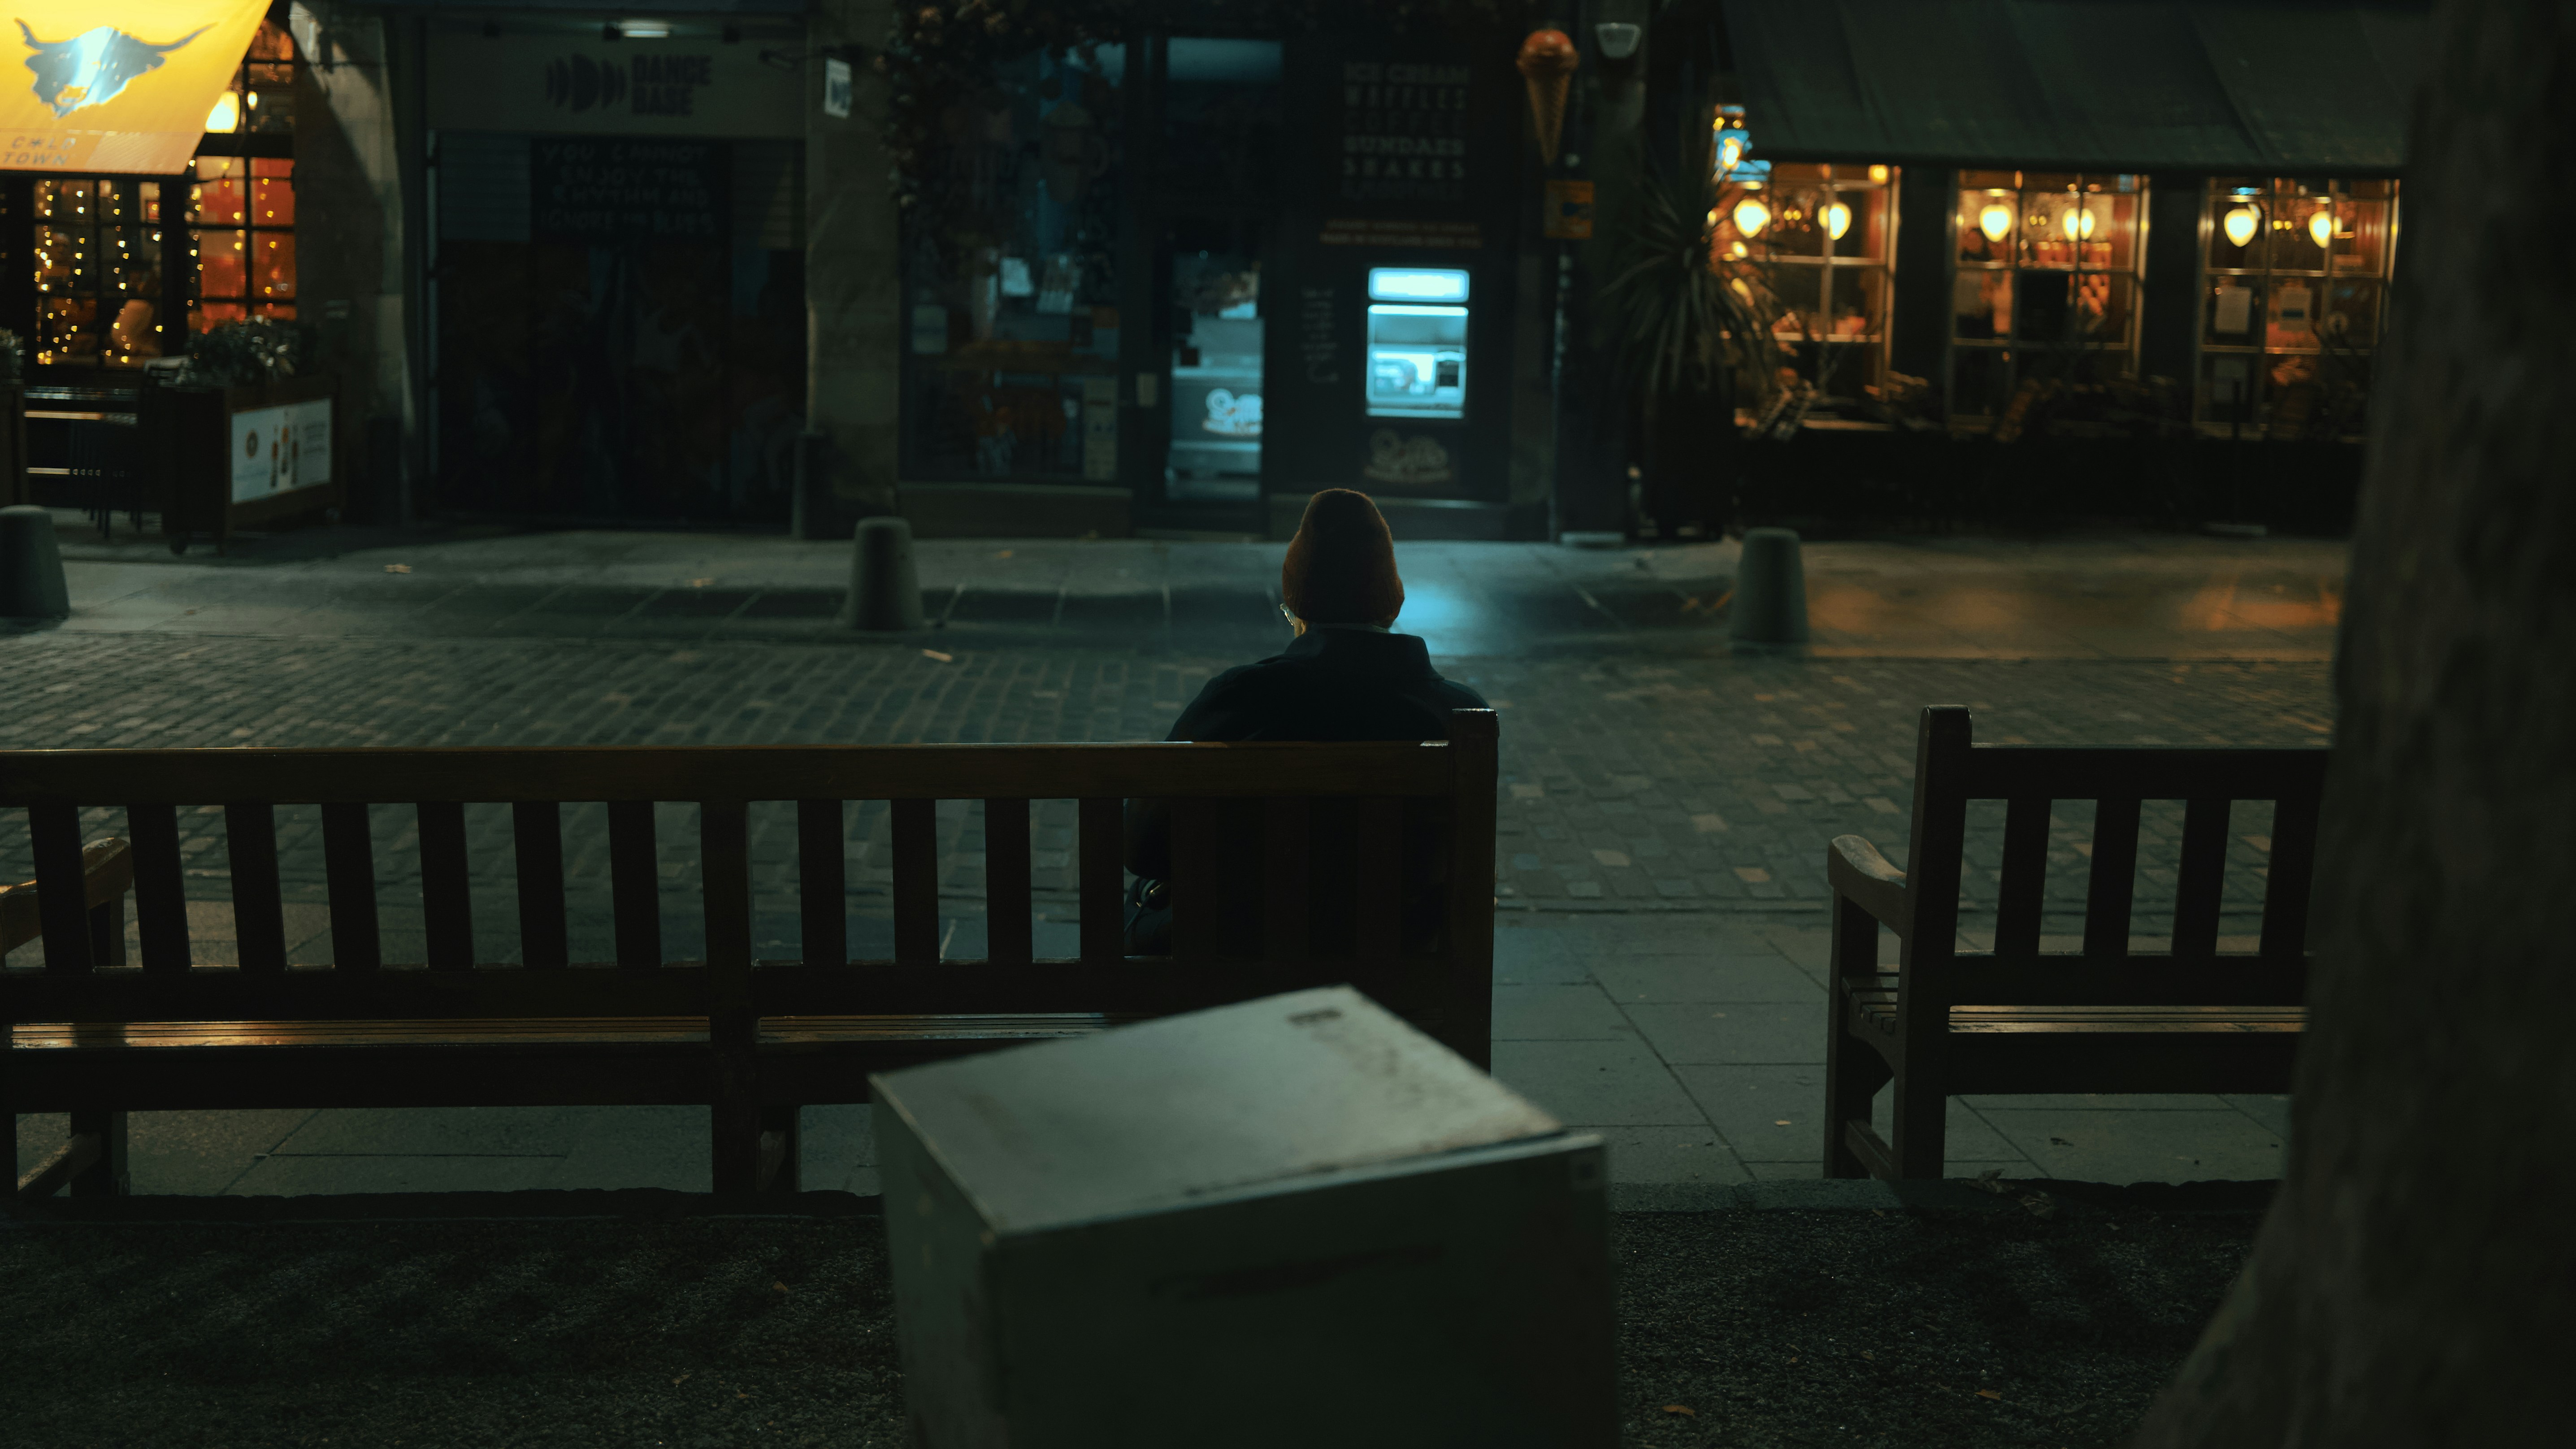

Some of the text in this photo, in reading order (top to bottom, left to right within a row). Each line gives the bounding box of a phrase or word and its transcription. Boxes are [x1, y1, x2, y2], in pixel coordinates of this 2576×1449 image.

[632, 54, 712, 85] DANCE
[1342, 62, 1470, 85] ICE CREAM
[632, 86, 693, 115] BASE
[1343, 86, 1467, 110] WAFFLES
[1343, 110, 1467, 135] COFFEE
[542, 143, 707, 165] YOU CANNOT
[1342, 136, 1466, 156] SUNDAES
[3, 151, 69, 166] TOWN
[1343, 157, 1466, 179] SHAKES
[560, 166, 699, 187] ENJOY THE
[667, 188, 711, 208] AND
[539, 207, 615, 230] IGNORE
